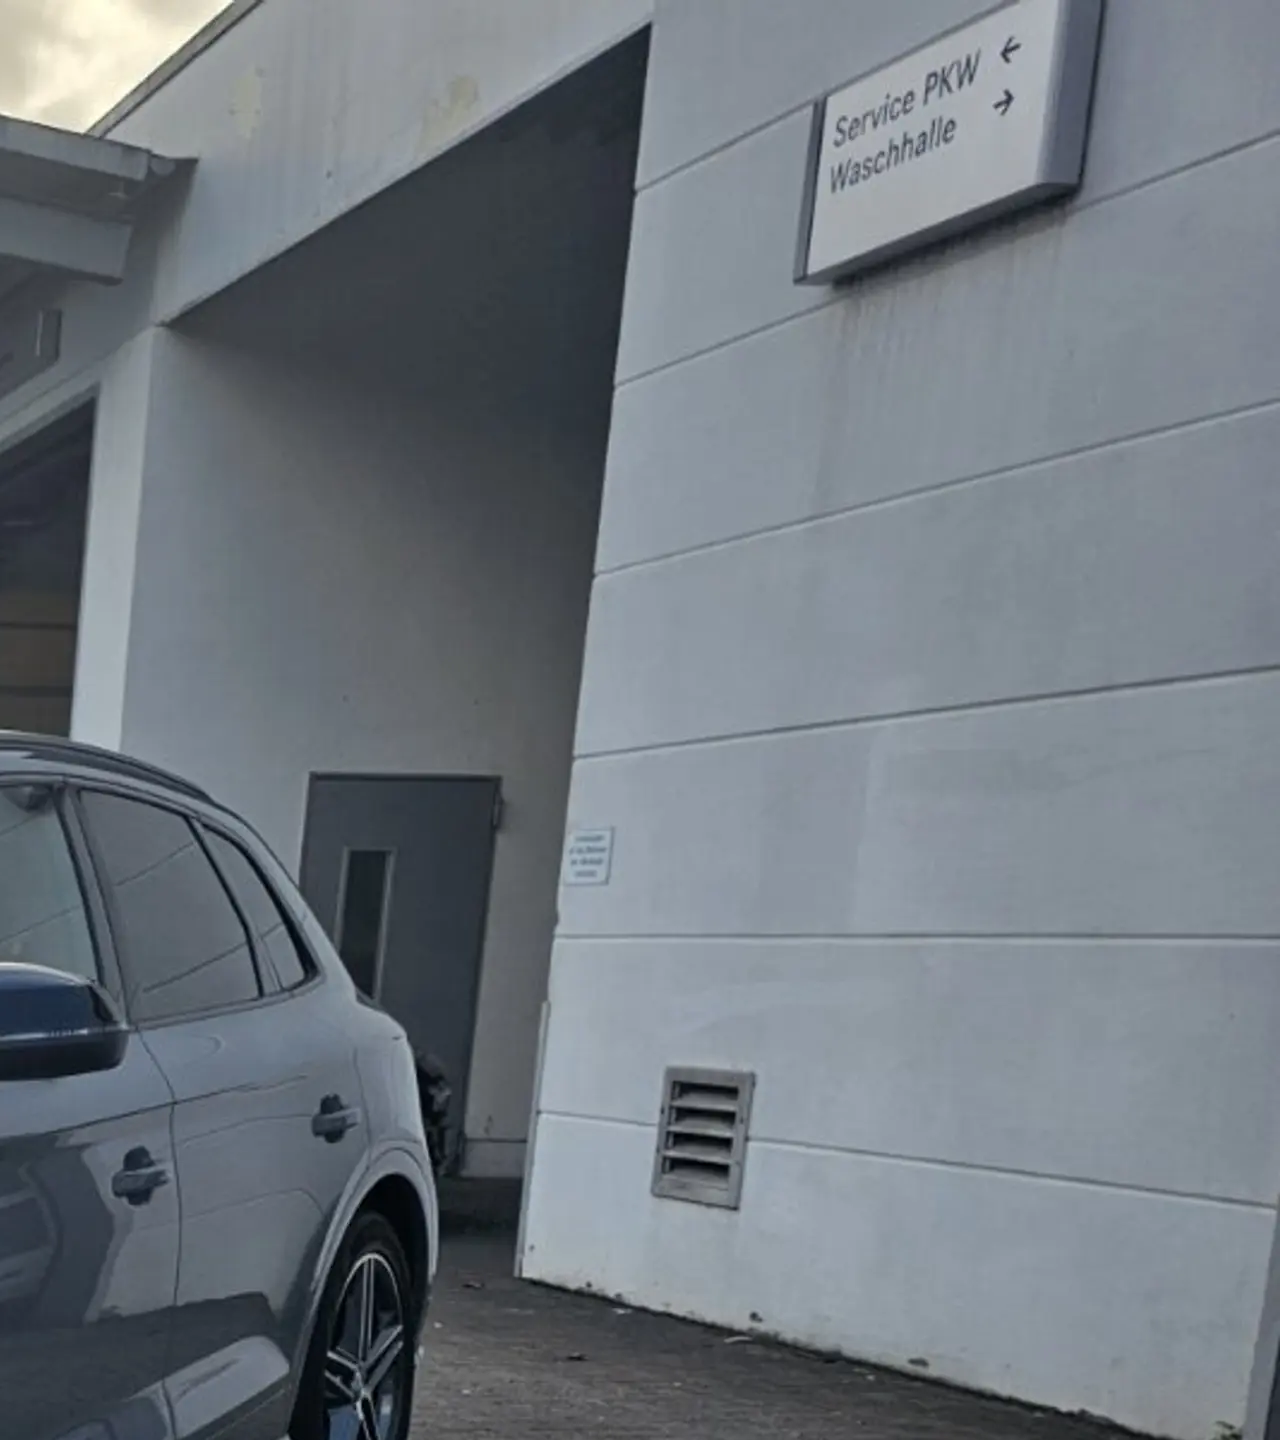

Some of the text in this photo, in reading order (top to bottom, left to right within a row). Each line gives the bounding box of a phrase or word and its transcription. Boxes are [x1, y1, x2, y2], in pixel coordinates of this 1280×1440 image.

[832, 48, 982, 148] Service PKW
[829, 115, 958, 194] Waschhalle
